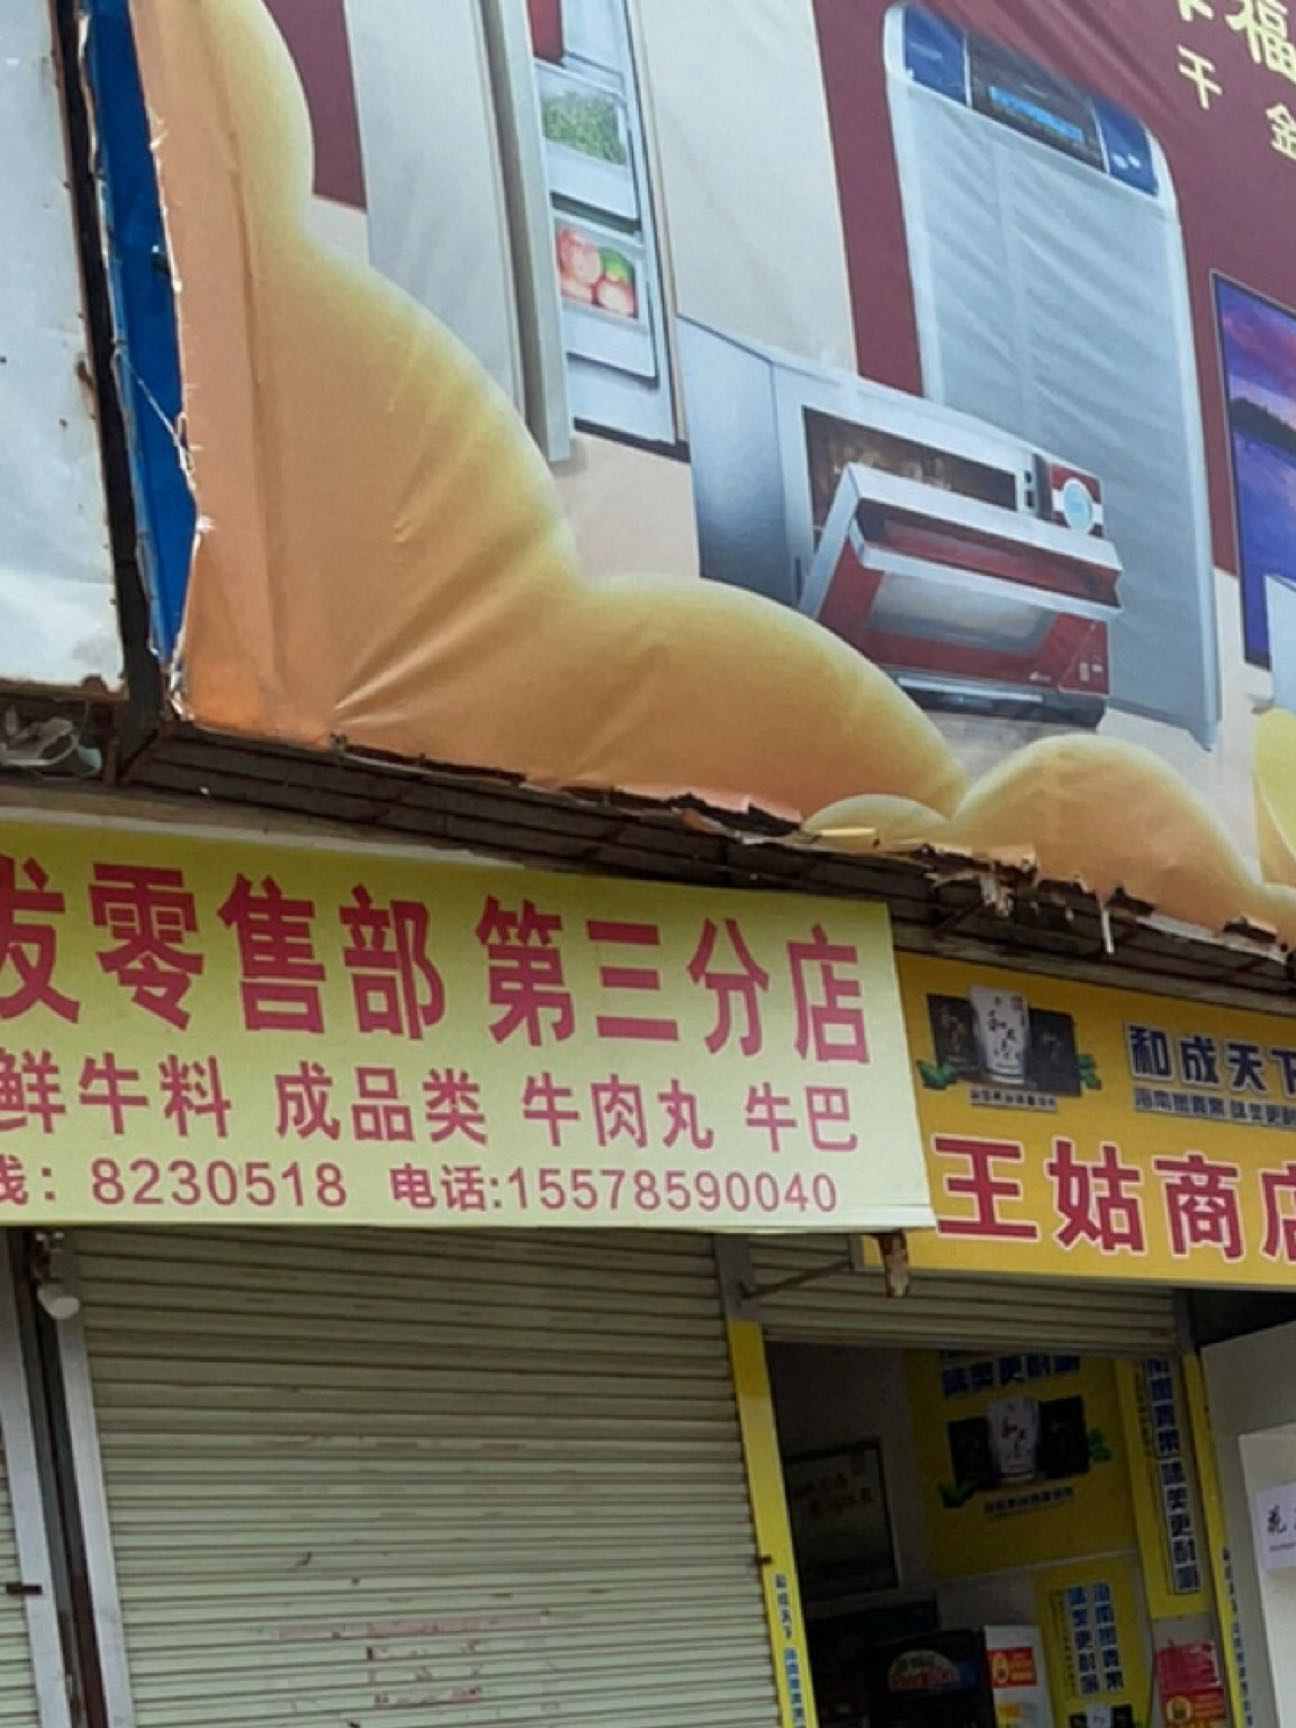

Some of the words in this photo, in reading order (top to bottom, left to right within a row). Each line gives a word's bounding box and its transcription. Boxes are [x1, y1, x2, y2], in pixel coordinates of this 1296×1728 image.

[475, 894, 872, 1065] 第三分店
[274, 1060, 489, 1146] 成品类
[520, 1071, 715, 1154] 牛肉丸
[744, 1081, 859, 1154] 牛巴
